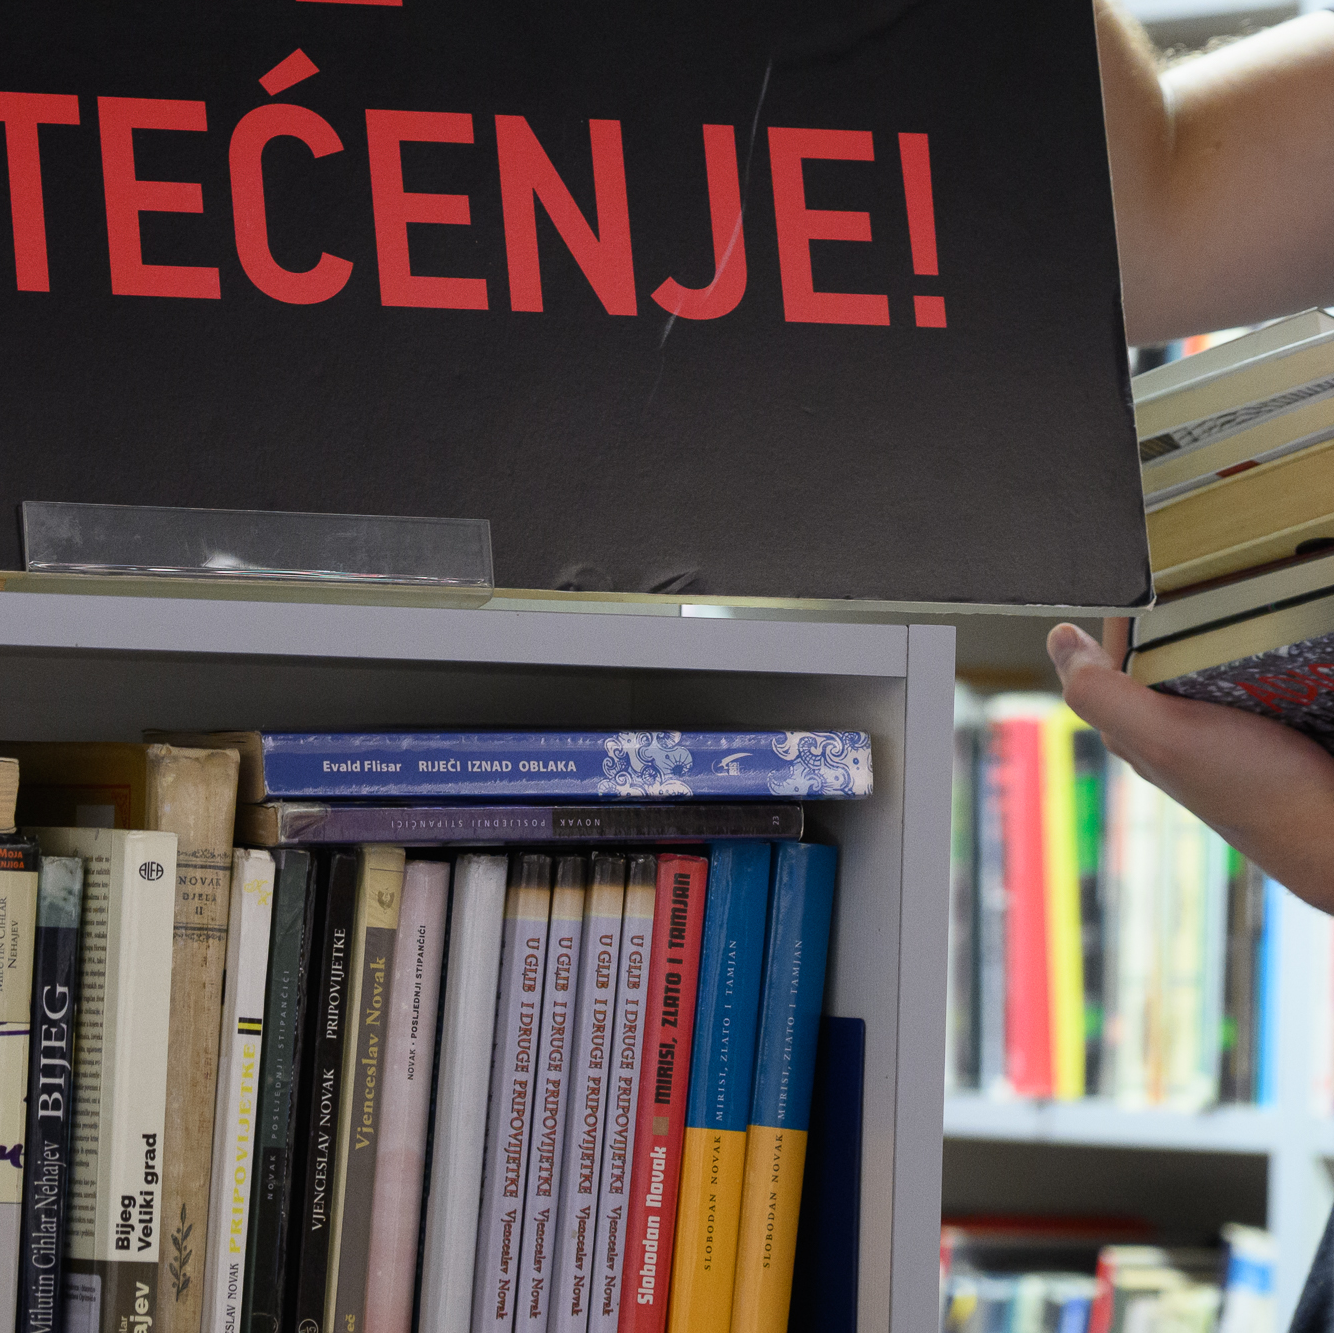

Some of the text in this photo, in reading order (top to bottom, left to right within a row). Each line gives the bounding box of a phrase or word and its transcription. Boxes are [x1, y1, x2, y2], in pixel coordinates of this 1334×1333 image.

[323, 758, 577, 773] Evald Flisar RIJEČI IZNAD OBLAKA
[390, 819, 464, 831] STIPANČIĆI
[471, 819, 546, 829] POSLJEDNJI
[560, 818, 601, 827] NOVAK
[139, 860, 164, 882] ALFA
[178, 875, 222, 888] NOVAK
[182, 891, 218, 903] DJELA
[195, 906, 204, 916] II
[726, 940, 737, 996] TAMJAN
[407, 924, 427, 1081] NOVAK POSLJEDNJI STIPANČIĆI
[355, 956, 386, 1152] Vjenceslav Novak
[720, 1017, 731, 1062] ZLATO
[271, 1057, 285, 1140] POSLJEDNJI
[311, 927, 346, 1232] VJENCESLAV NOVAK PRIPOVIJETKE
[637, 872, 691, 1305] Slobodan Novak MIRISI, ZLATO I TAMJAN
[716, 1066, 729, 1121] MIRISI,
[762, 1192, 777, 1269] SLOBODAN
[771, 1134, 784, 1183] NOVAK
[783, 1016, 795, 1061] ZLATO
[790, 939, 803, 994] TAMJAN
[228, 1043, 257, 1255] PRIPOVIJETKE
[495, 937, 541, 1320] U GLIB I DRUGE PRIPOVIJETKE Vjenceslav Novak
[529, 936, 573, 1319] U GLIB I DRUGE PRIPOVIJETKE Vjenceslav Novak
[571, 933, 614, 1316] U GLIB I DRUGE PRIPOVIJETKE Vjenceslav Novak
[602, 934, 644, 1317] U GLIB I DRUGE PRIPOVIJETKE Vjenceslav Novak
[29, 982, 71, 1333] Milutin Cihlar Nehajev BIJEG
[267, 1154, 277, 1200] NOVAK
[710, 1135, 721, 1185] NOVAK
[137, 1132, 160, 1252] Veliki grad
[115, 1194, 137, 1251] Bijeg
[704, 1193, 717, 1271] SLOBODAN
[130, 1280, 153, 1333] ajev
[227, 1262, 239, 1300] NOVAK
